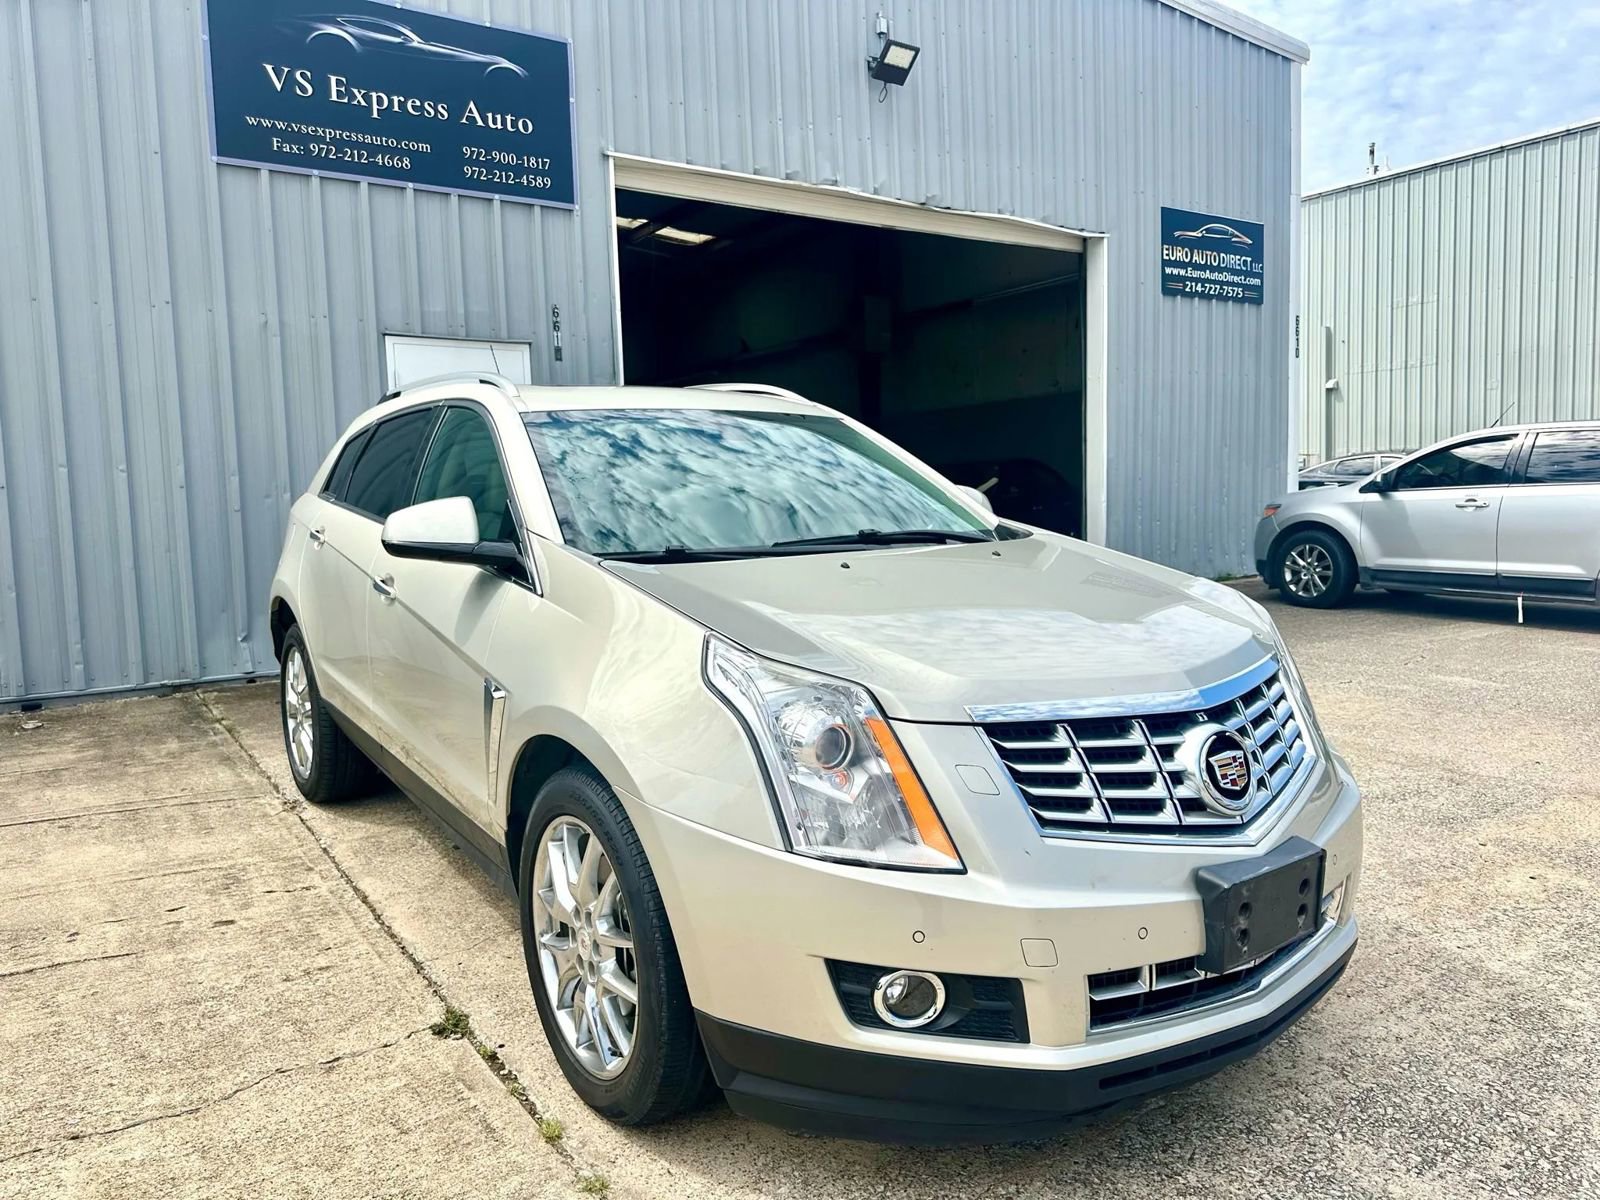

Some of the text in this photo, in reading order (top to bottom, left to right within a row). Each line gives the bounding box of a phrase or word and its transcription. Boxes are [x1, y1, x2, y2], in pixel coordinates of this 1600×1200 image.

[262, 63, 535, 135] VS Express Auto
[244, 115, 432, 153] www.vsexpressauto.com
[271, 137, 412, 170] Fax: 972-212-4668
[462, 146, 551, 171] 972-900-1817
[463, 165, 552, 189] 972-212-4589
[1162, 244, 1263, 273] EURO AUTO DIRECT LLC
[1164, 266, 1262, 286] www.EuroAutoDirect.com
[1184, 281, 1244, 298] 214-727-7575
